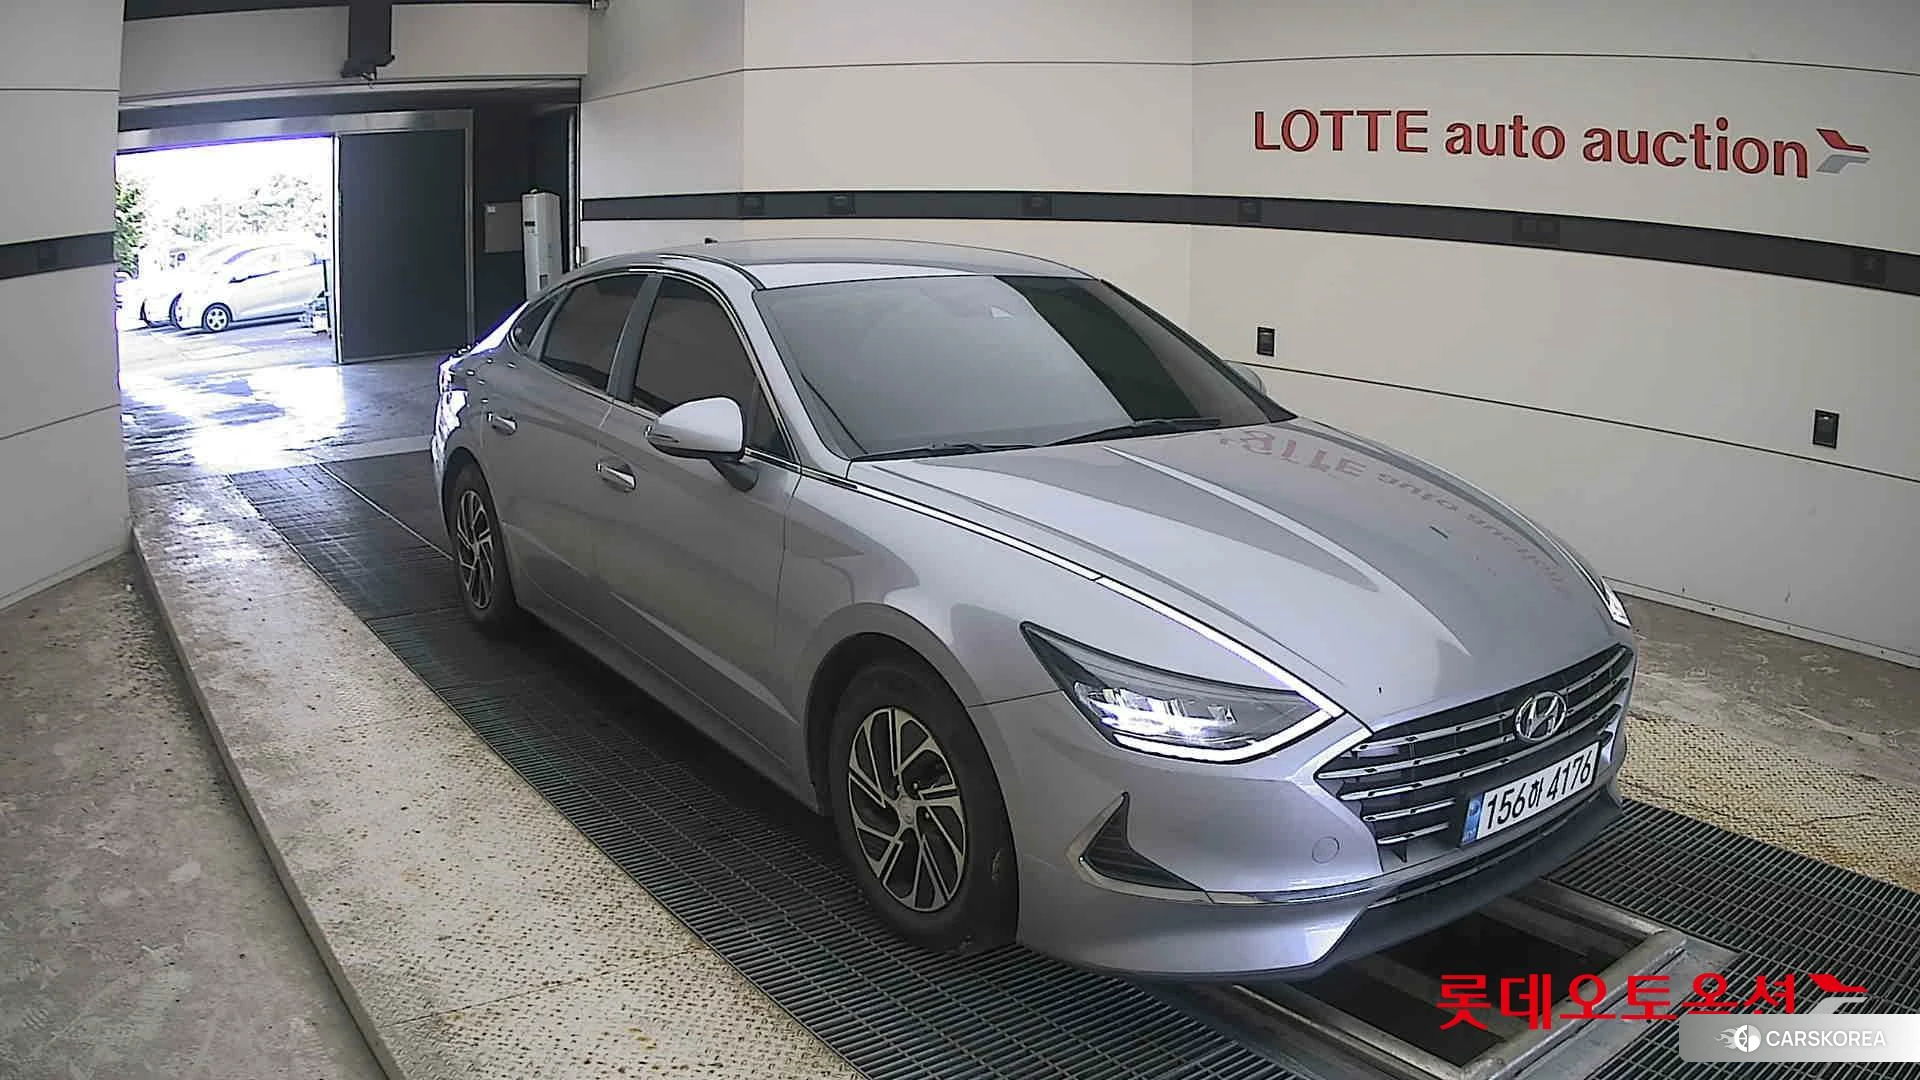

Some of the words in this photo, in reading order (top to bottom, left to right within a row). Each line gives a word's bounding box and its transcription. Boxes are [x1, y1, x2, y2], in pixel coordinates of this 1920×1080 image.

[1253, 109, 1429, 154] LOTTE
[1445, 115, 1567, 160] auto
[1583, 117, 1809, 179] auction
[1487, 777, 1544, 830] 156하
[1546, 750, 1593, 801] 4176
